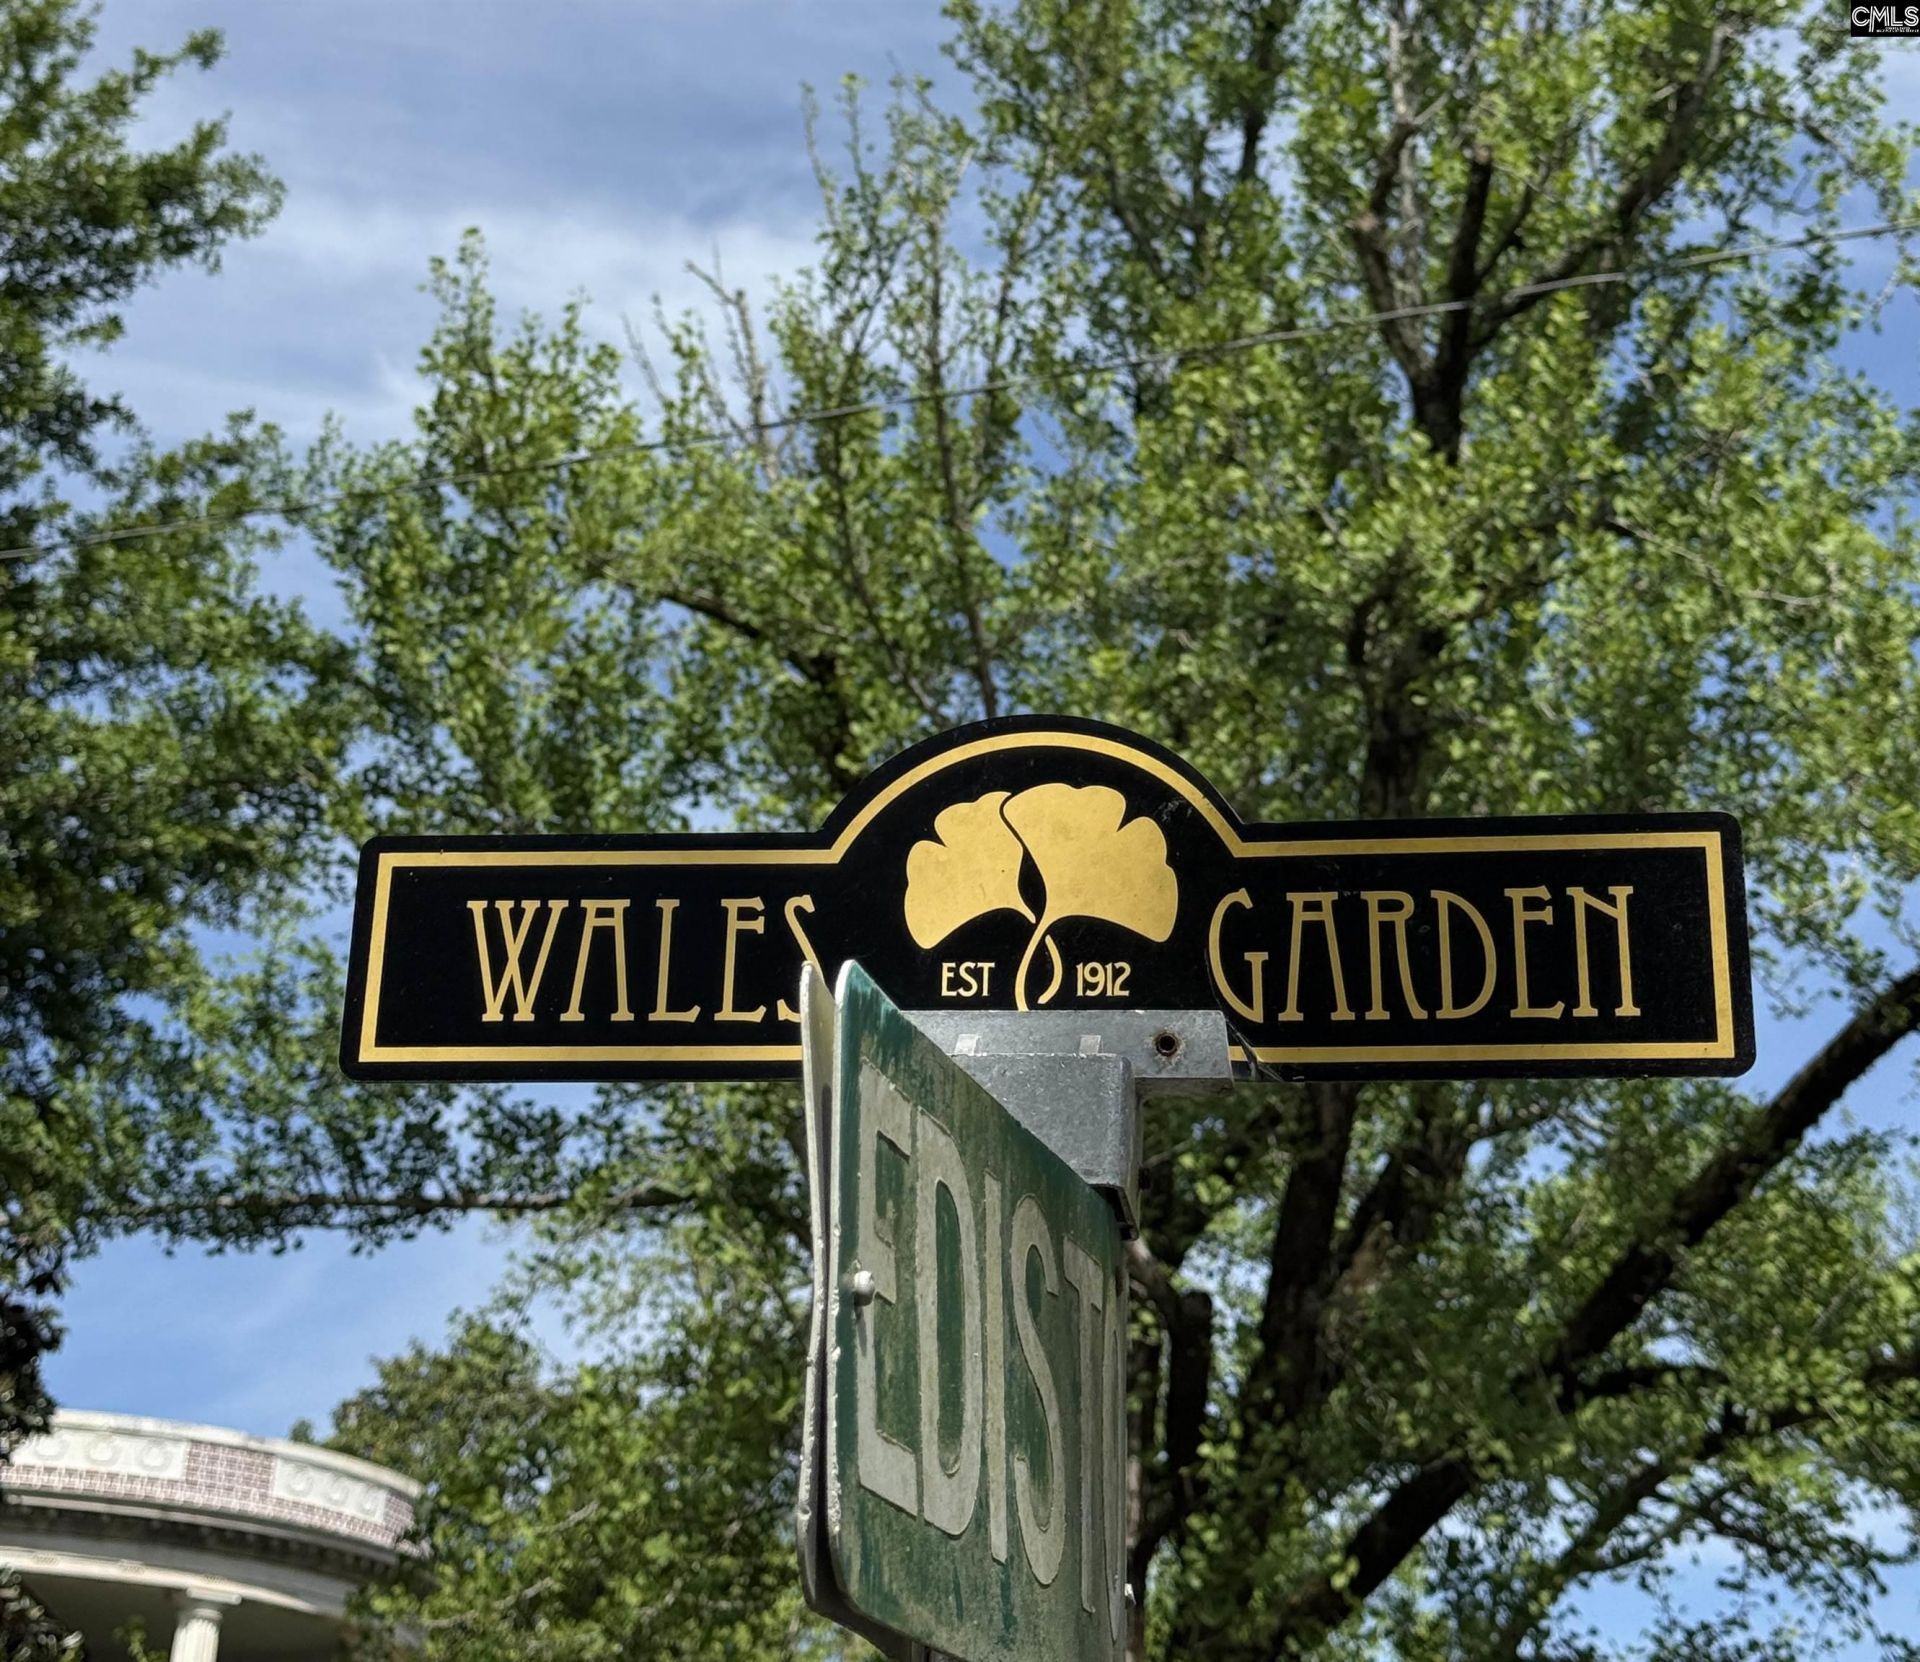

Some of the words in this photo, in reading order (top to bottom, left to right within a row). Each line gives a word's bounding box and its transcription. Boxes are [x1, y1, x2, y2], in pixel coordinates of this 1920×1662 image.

[941, 962, 995, 997] EST
[1076, 961, 1131, 997] 1912
[1209, 885, 1641, 1023] GARDEN
